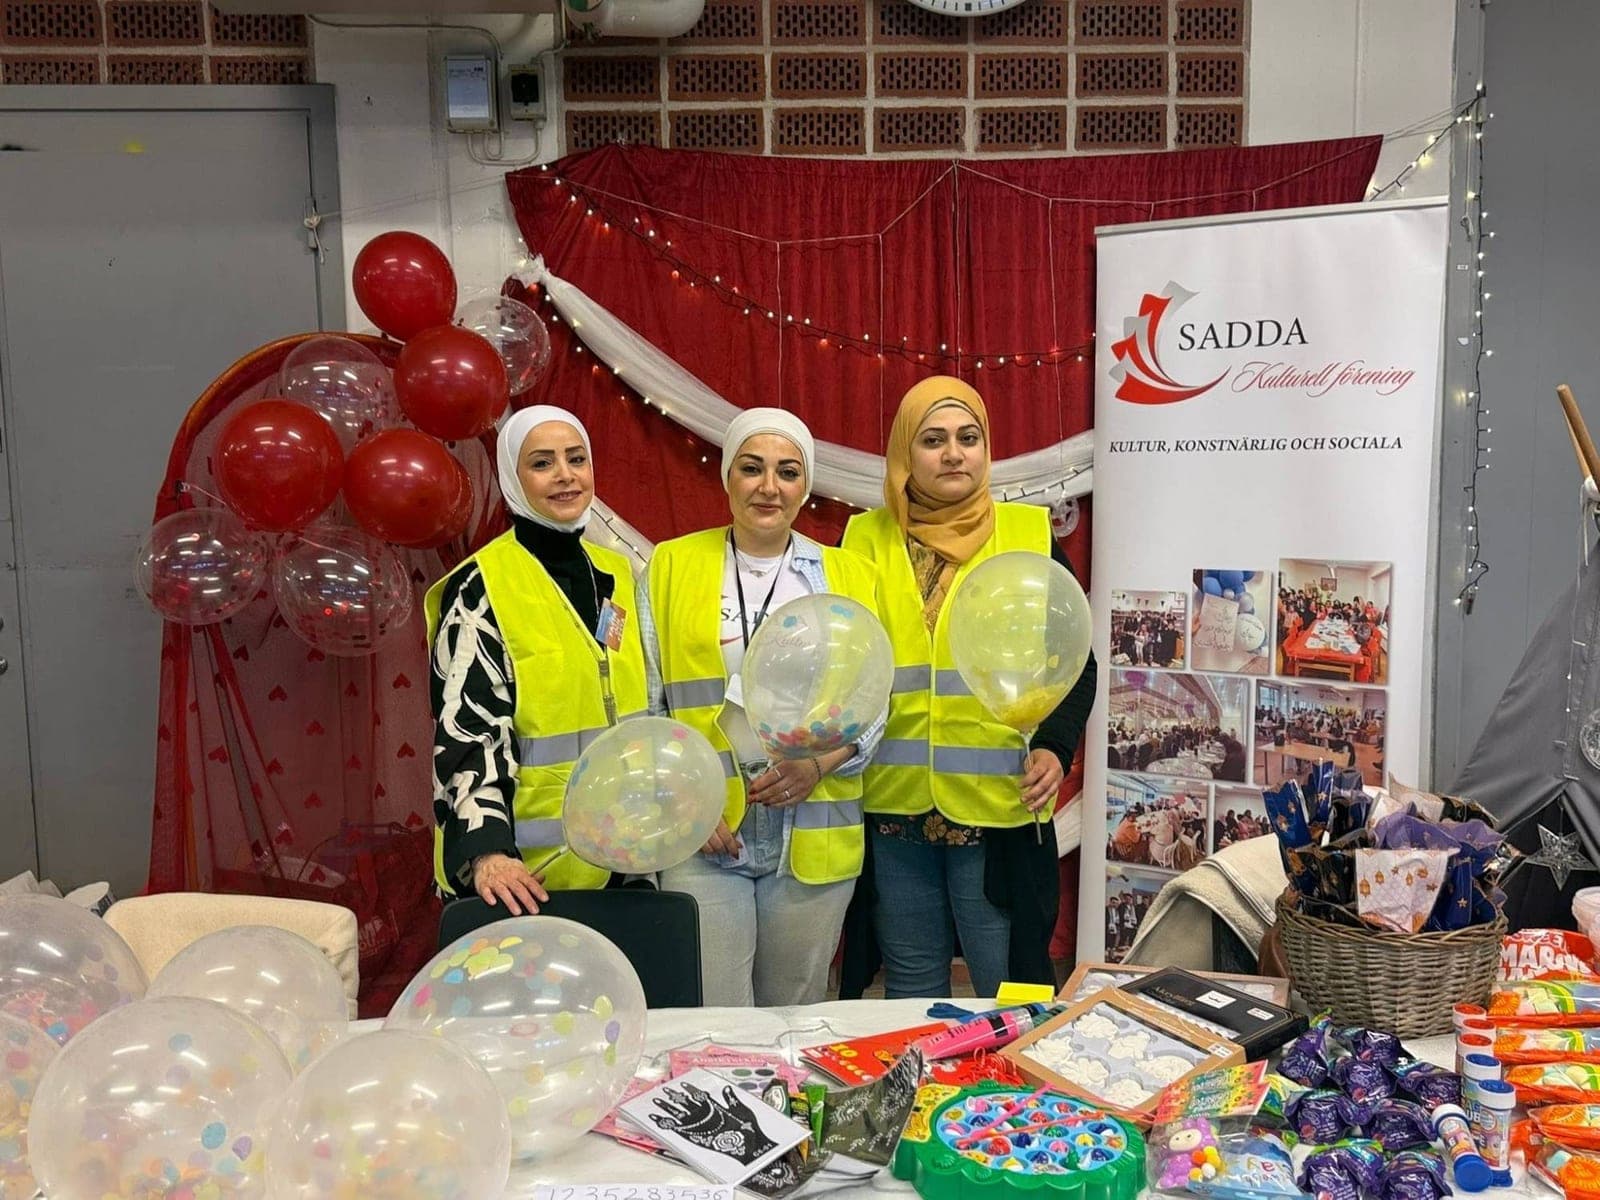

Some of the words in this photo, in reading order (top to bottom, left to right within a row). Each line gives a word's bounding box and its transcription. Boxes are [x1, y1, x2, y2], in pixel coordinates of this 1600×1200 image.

[1178, 317, 1309, 351] SADDA
[1231, 361, 1334, 394] Kulturell
[1109, 440, 1171, 454] KULTUR,
[1174, 437, 1288, 453] KONSTNÄRLIG
[1291, 437, 1325, 450] OCH
[1329, 436, 1403, 450] SOCIALA
